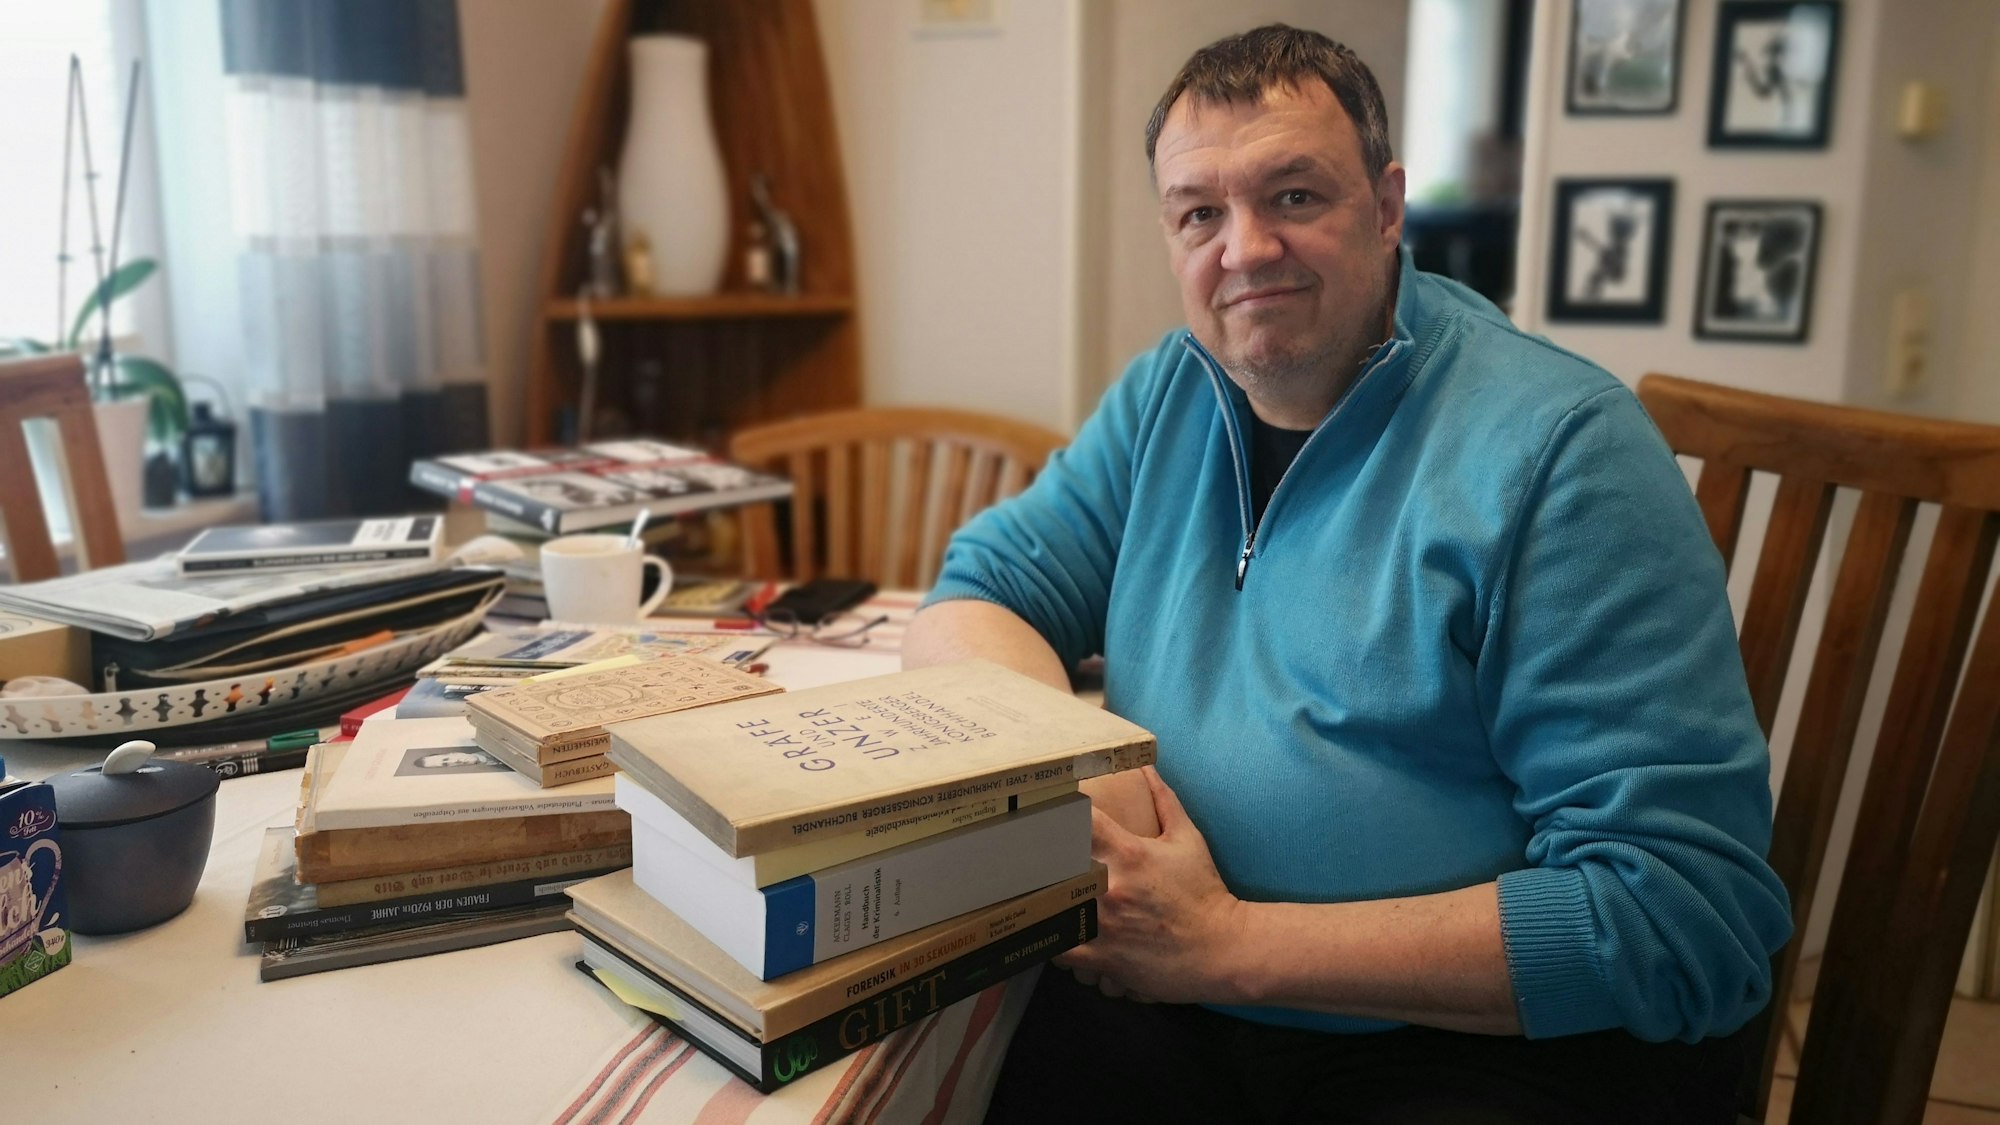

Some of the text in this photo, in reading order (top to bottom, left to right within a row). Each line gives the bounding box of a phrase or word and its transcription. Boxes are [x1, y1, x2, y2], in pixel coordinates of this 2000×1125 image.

[855, 699, 951, 746] JAHRHUNDERTE
[878, 694, 975, 743] KÖNIGSBERGER
[901, 690, 998, 739] BUCHHANDEL
[552, 736, 609, 755] WEISHEITEN
[736, 718, 836, 772] GRÄFE
[798, 708, 900, 760] UNZER
[800, 729, 836, 748] UND
[1006, 773, 1028, 787] ZWEI
[1034, 766, 1063, 781] UNZER
[936, 779, 1003, 802] JAHRHUNDERTE
[413, 808, 456, 820] Ostpreußen
[472, 803, 535, 815] Volkserzählungen
[537, 800, 583, 811] Plattdeutsche
[590, 799, 616, 807] rannas
[862, 793, 934, 819] KÖNIGSBERGER
[792, 811, 858, 835] BUCHHANDEL
[373, 853, 593, 894] Land und Leute in Wort und Bild
[456, 892, 490, 907] FRAUEN
[894, 879, 902, 906] Auflage
[1070, 883, 1097, 900] Librero
[371, 906, 401, 920] JAHRE
[435, 898, 454, 910] DER
[834, 890, 842, 942] ACKERMANN
[861, 885, 870, 930] Handbuch
[320, 914, 352, 926] Thomas
[843, 911, 851, 942] CLAGES
[1004, 933, 1060, 965] BEN HUBBARD
[846, 932, 977, 998] FORENSIK IN 30 SEKUNDEN
[838, 969, 947, 1050] GIFT
